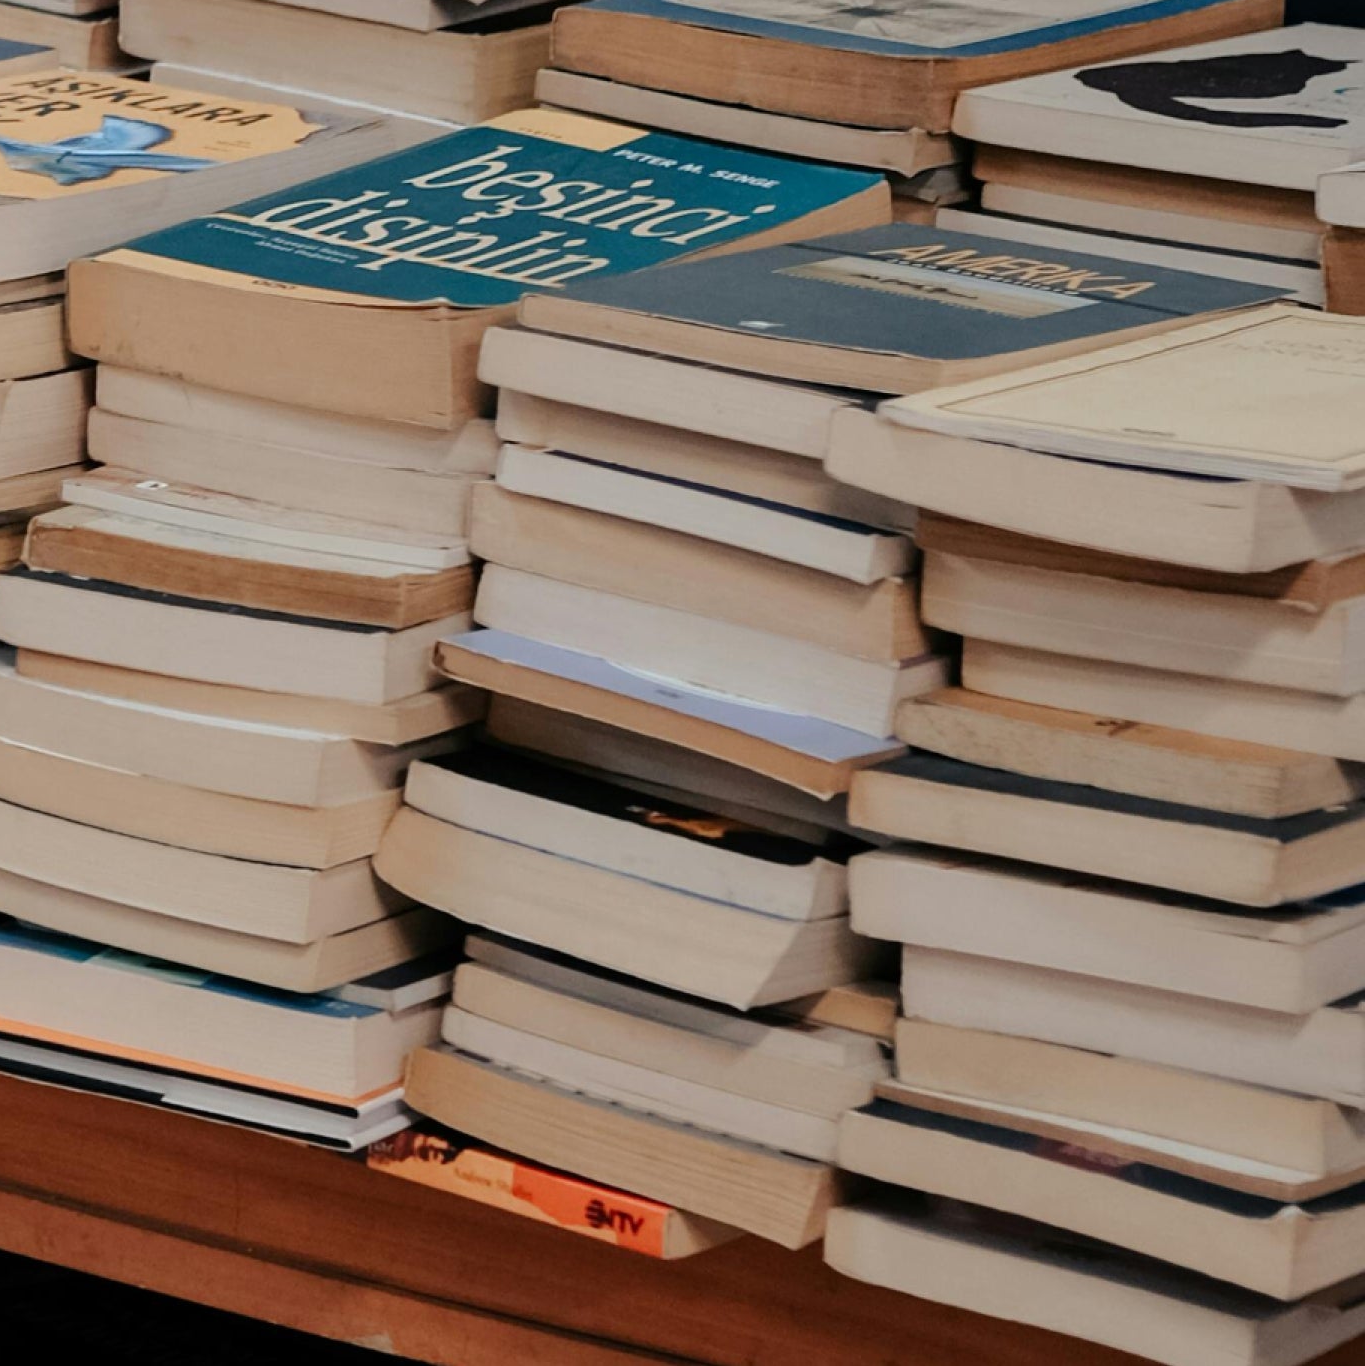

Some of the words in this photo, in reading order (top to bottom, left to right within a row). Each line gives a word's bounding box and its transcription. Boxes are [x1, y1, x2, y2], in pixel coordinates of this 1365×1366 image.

[13, 75, 273, 129] AŞIKLARA
[402, 145, 778, 247] beşinci
[613, 147, 674, 171] PETER
[707, 169, 781, 191] SENGE
[249, 190, 616, 290] disiplin
[602, 1207, 646, 1237] NTV
